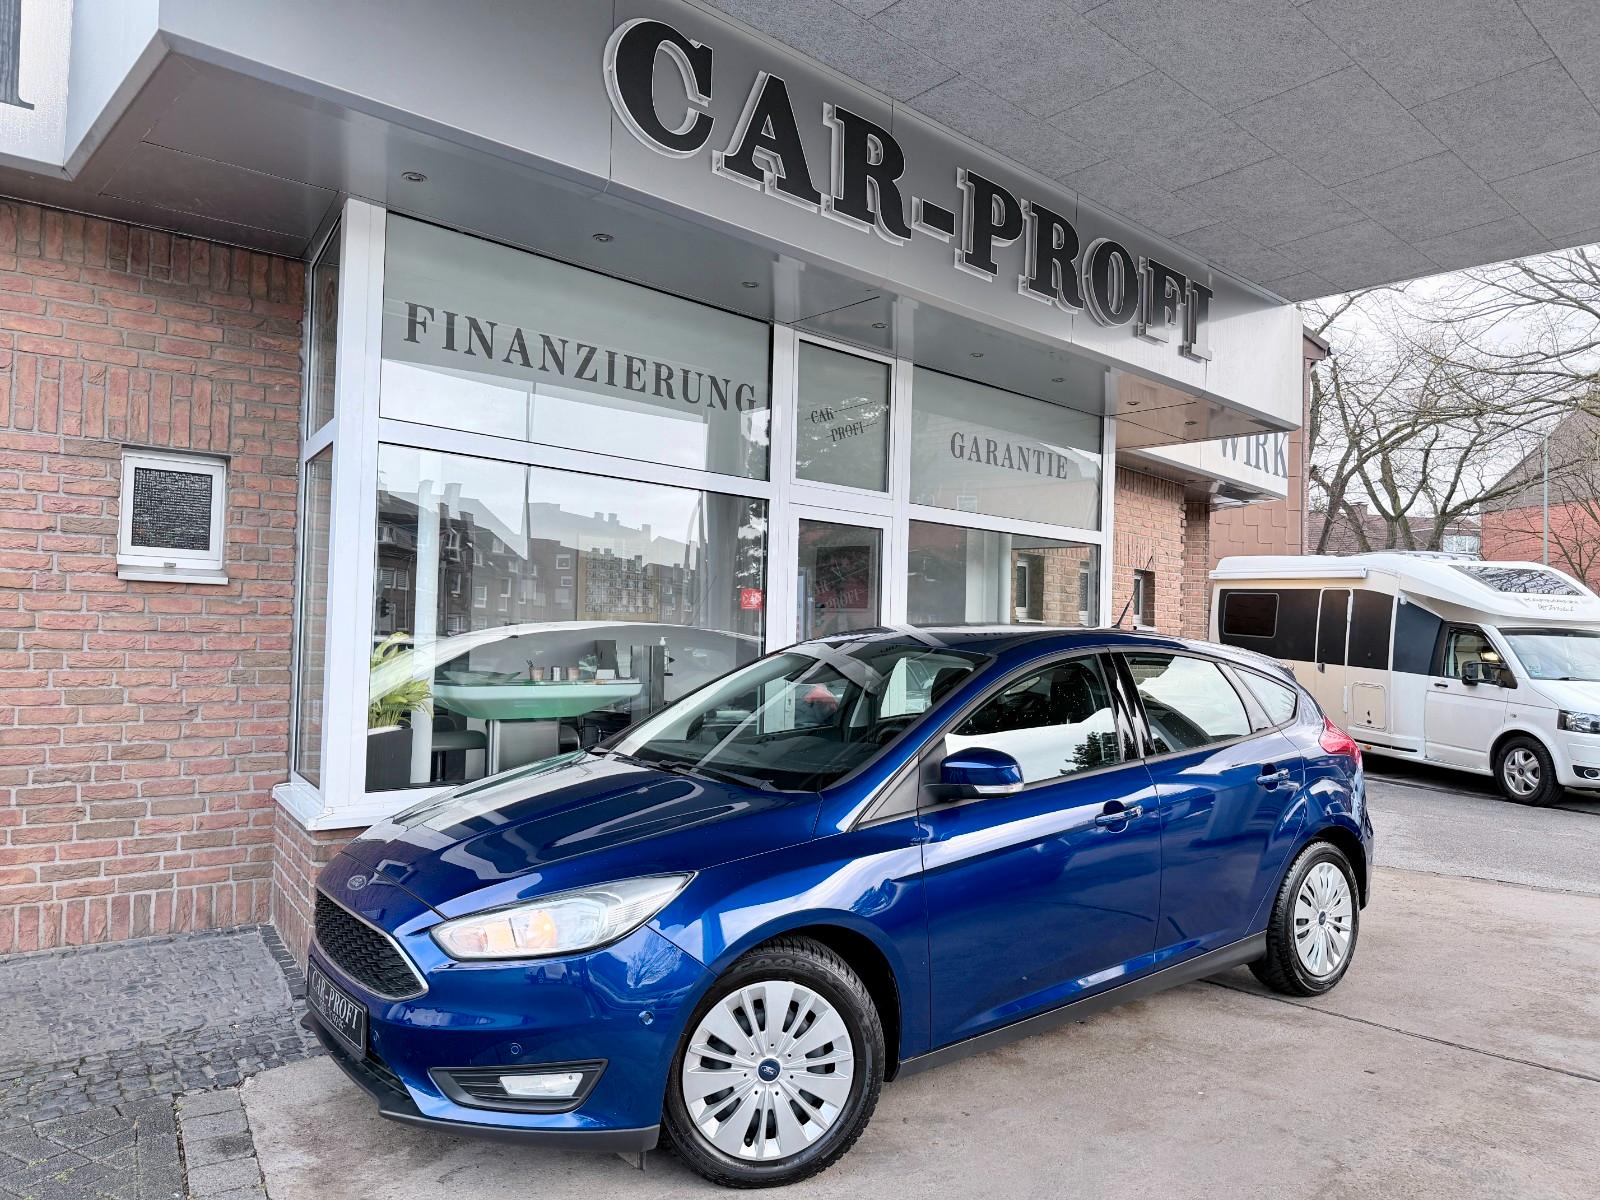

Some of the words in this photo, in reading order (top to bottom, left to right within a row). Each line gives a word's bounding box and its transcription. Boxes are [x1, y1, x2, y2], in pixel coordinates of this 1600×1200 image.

[603, 17, 1213, 361] CAR-PROFI
[403, 301, 757, 412] FINANZIERUNG
[811, 407, 834, 425] CAR
[830, 420, 864, 442] PROFI
[951, 431, 1067, 480] GARANTIE
